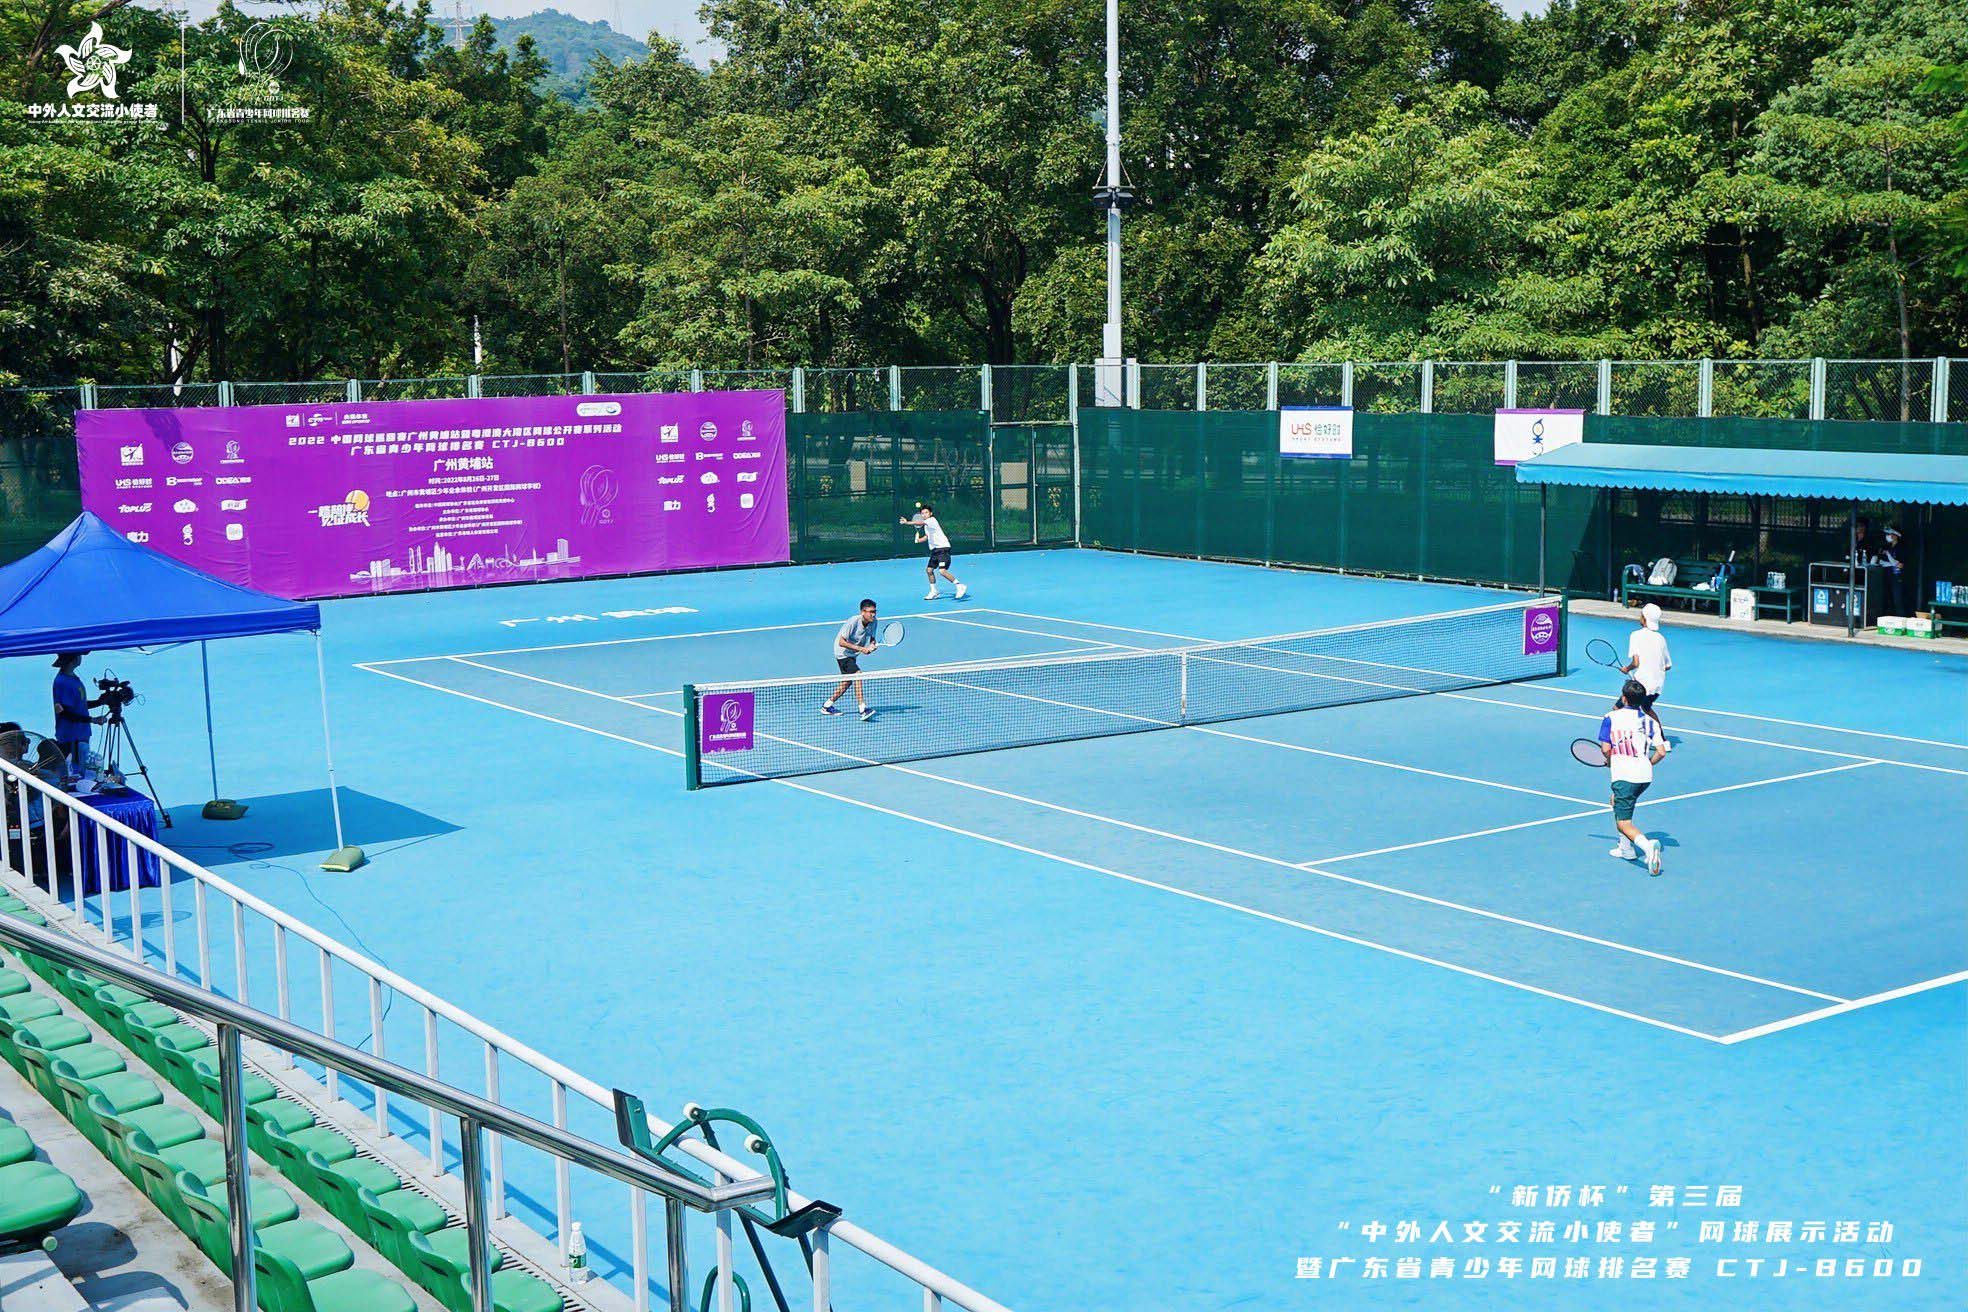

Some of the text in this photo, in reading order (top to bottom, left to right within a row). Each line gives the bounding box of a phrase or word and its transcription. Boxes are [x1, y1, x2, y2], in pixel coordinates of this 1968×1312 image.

[1291, 422, 1312, 436] UHS
[288, 436, 326, 446] 2022
[433, 456, 494, 473] 广州黄埔站
